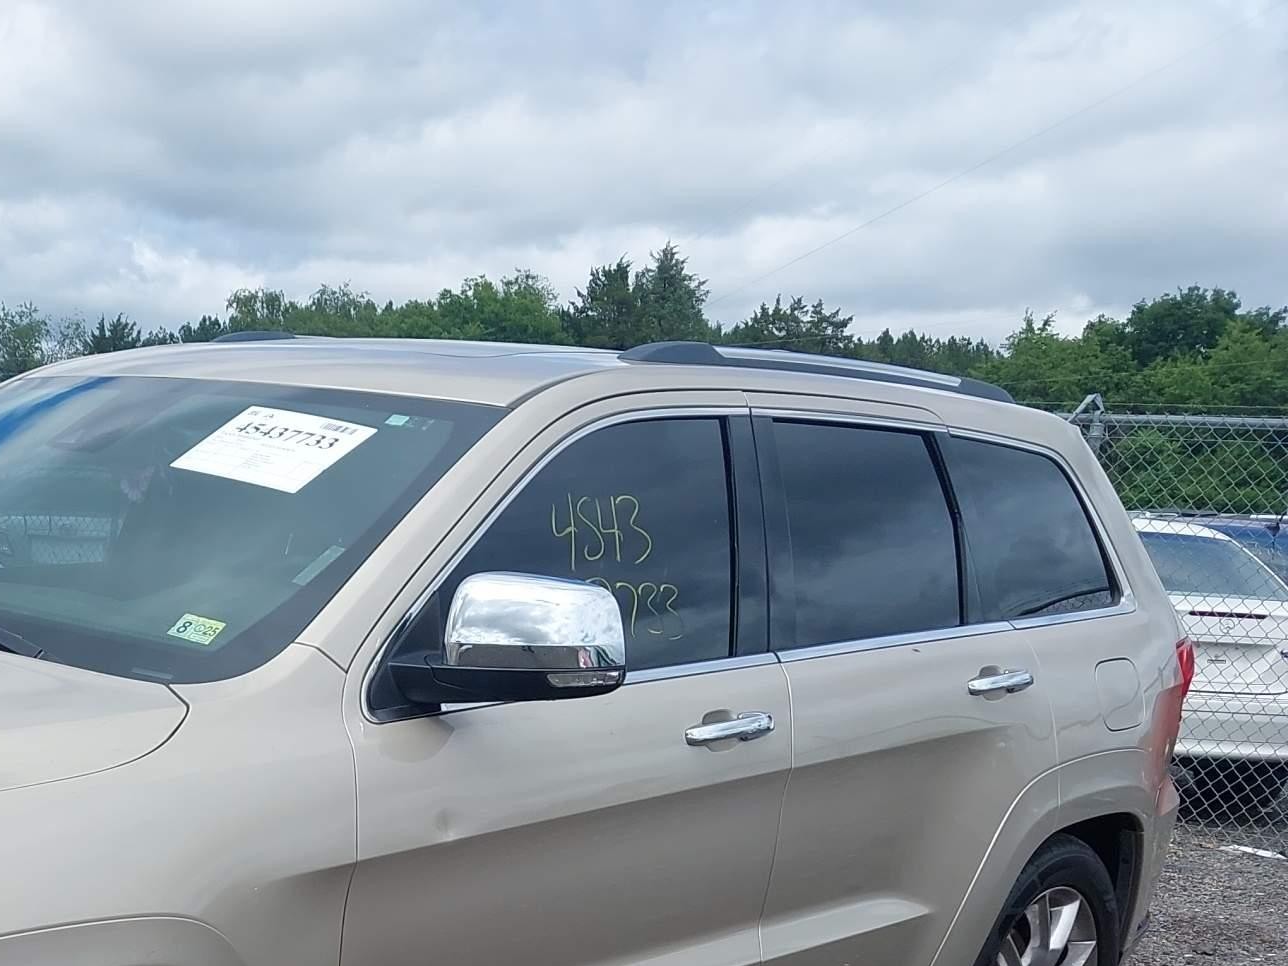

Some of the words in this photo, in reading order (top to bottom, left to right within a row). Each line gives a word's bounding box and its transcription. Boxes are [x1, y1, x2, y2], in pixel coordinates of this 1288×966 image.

[236, 421, 340, 450] 45437733
[551, 492, 652, 571] 4543
[176, 621, 193, 634] 8
[202, 625, 220, 637] 25
[585, 577, 684, 640] 733
